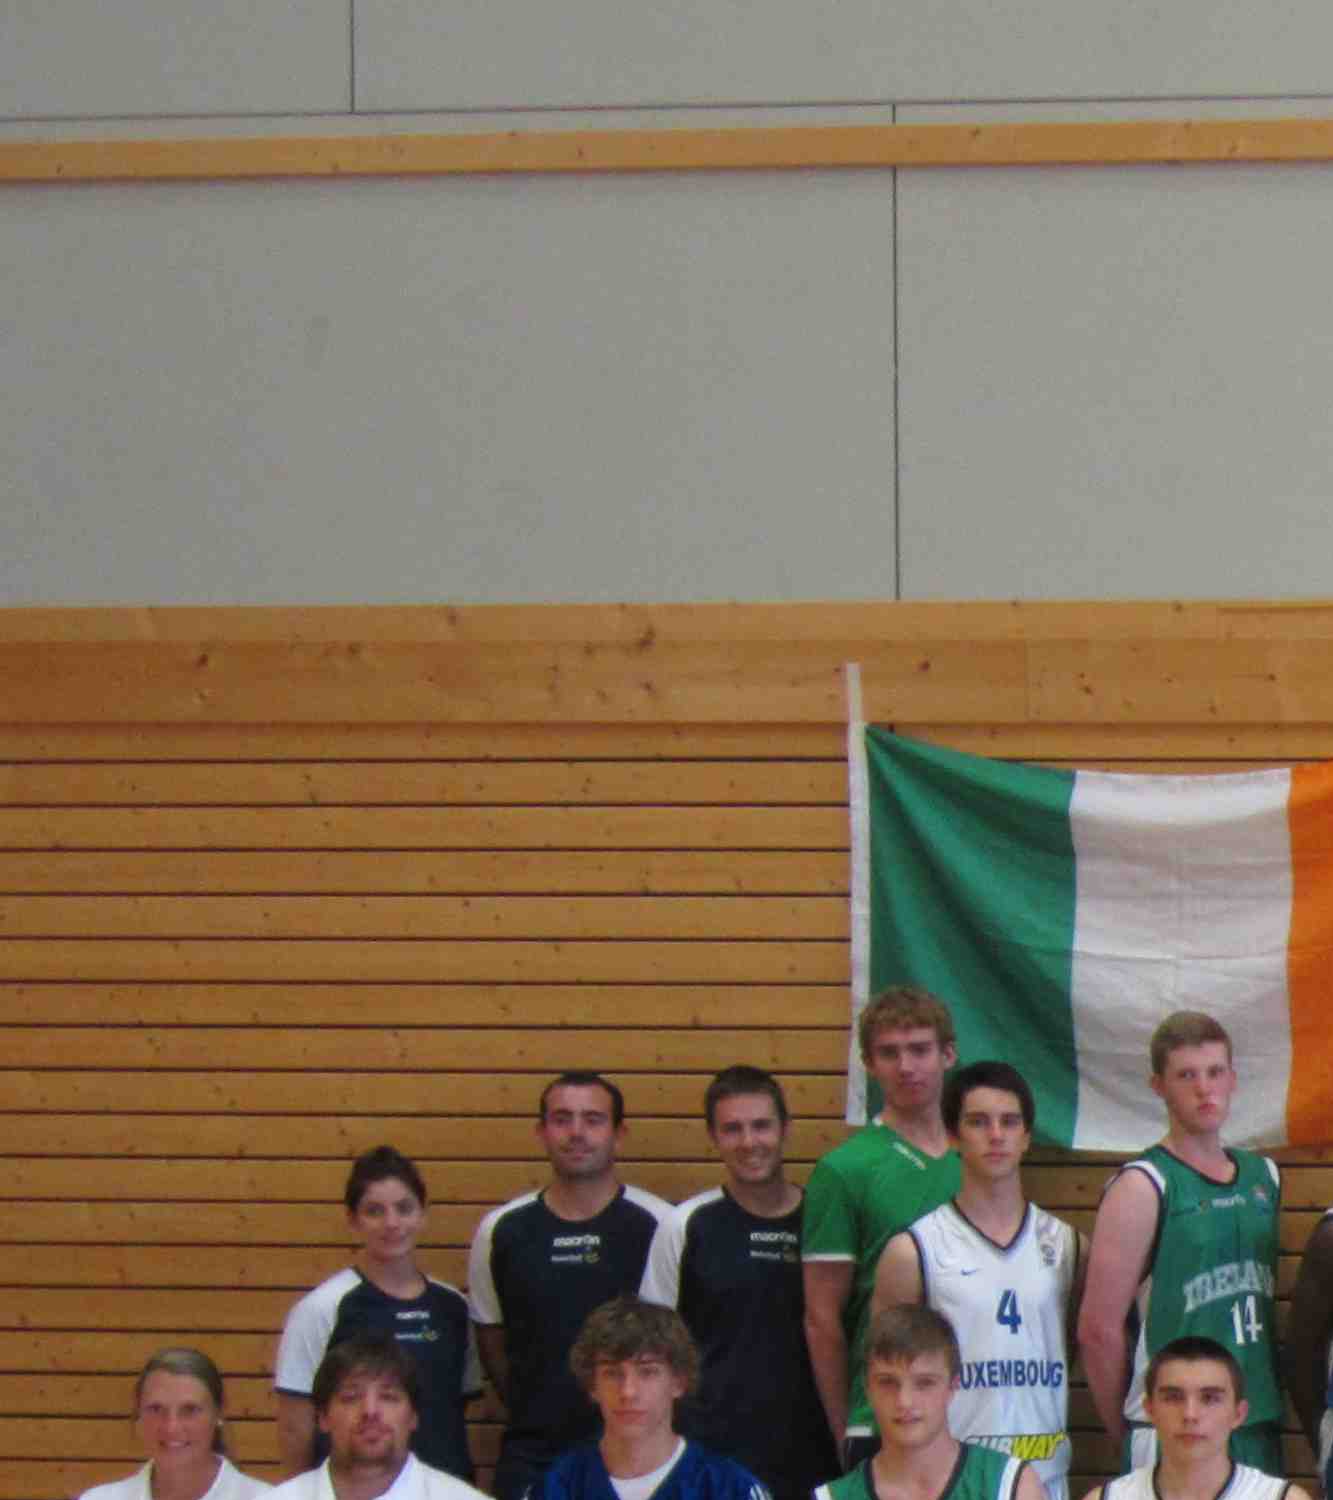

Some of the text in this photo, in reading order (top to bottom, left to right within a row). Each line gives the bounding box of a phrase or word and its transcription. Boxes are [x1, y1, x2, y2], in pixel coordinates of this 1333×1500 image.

[553, 1234, 601, 1247] macron
[996, 1289, 1023, 1334] 4
[1230, 1295, 1264, 1345] 14
